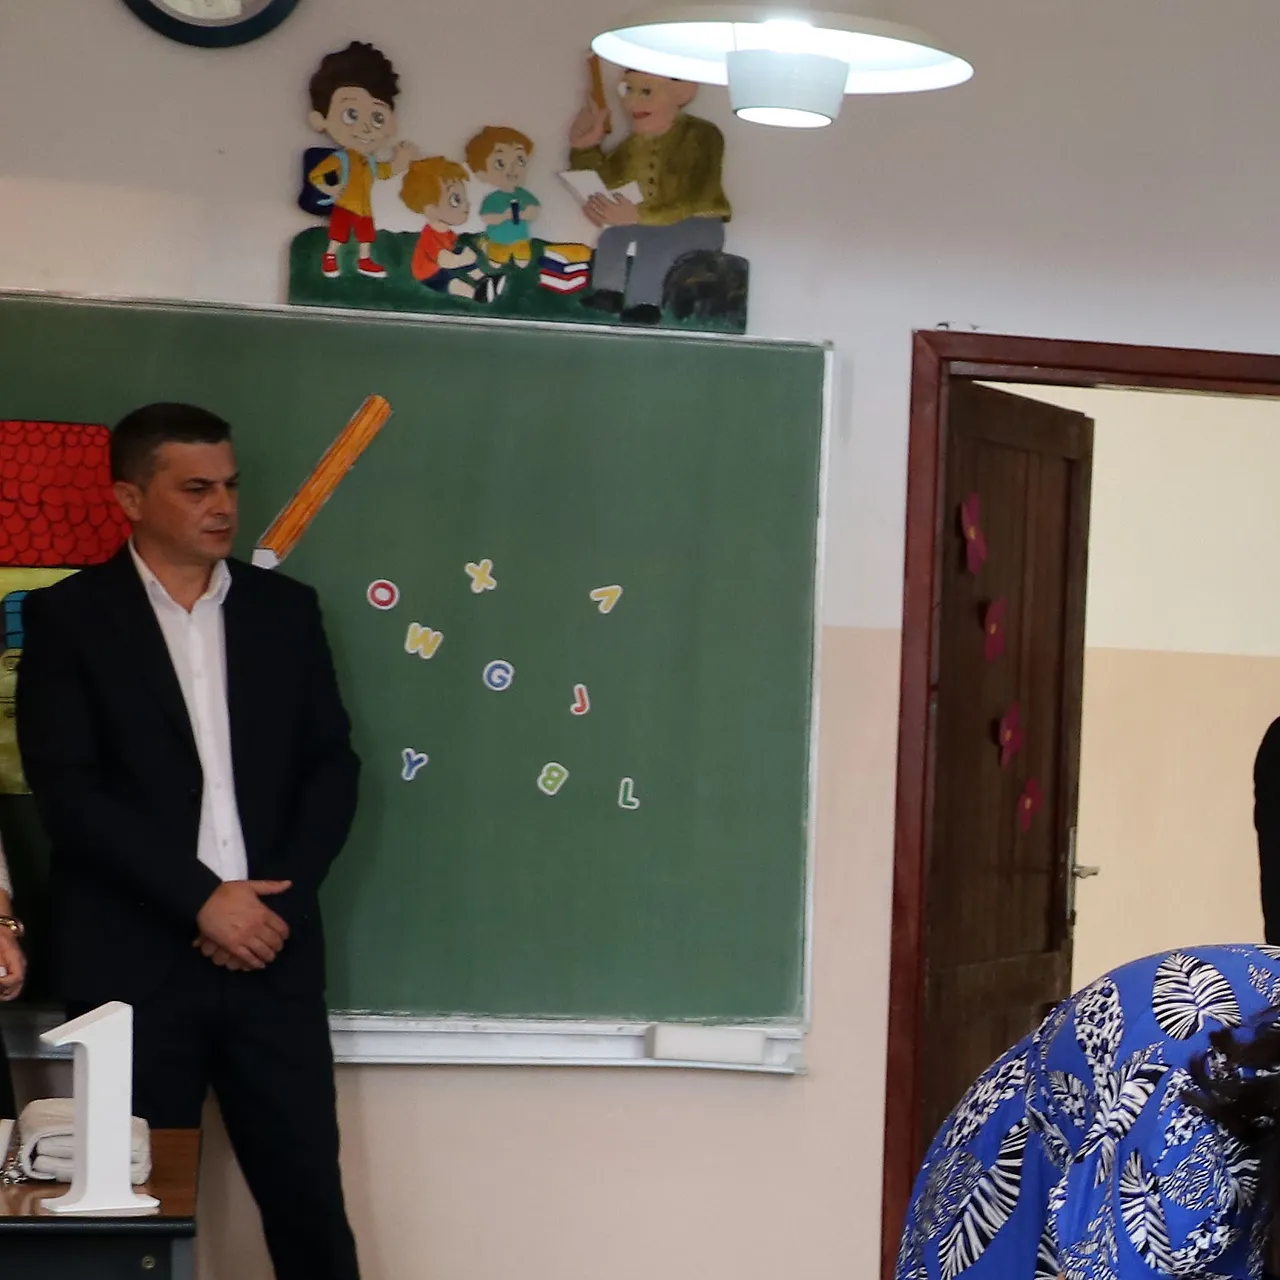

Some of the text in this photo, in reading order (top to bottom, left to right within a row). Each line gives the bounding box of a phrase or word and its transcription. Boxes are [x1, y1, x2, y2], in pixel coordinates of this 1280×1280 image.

[464, 558, 497, 593] X
[482, 659, 515, 691] G
[570, 683, 591, 715] J
[401, 748, 429, 781] Y
[618, 777, 640, 809] L
[39, 1000, 161, 1215] 1
